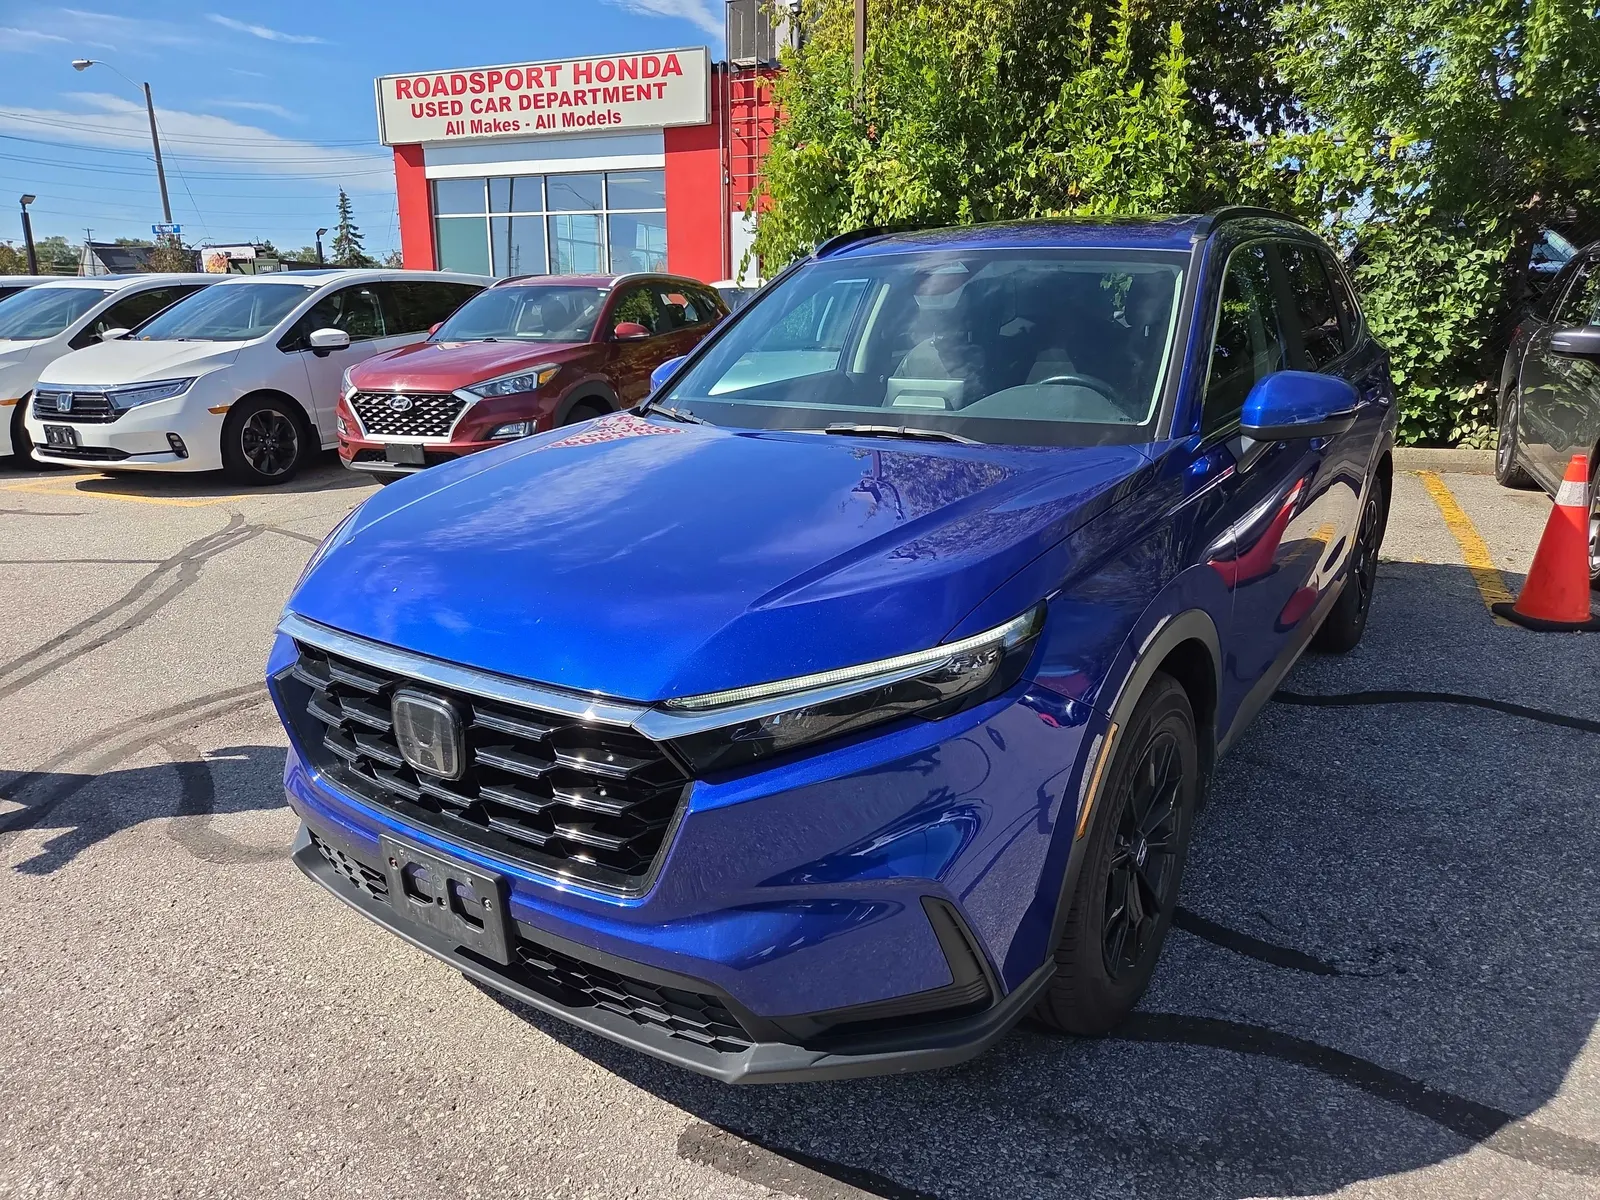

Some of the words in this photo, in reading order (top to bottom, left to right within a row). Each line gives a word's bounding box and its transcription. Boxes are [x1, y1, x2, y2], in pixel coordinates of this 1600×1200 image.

[396, 65, 562, 100] ROADSPORT
[573, 54, 682, 85] HONDA
[411, 100, 463, 118] USED
[470, 96, 511, 114] CAR
[519, 82, 667, 110] DEPARTMENT
[445, 121, 465, 135] All
[470, 119, 520, 134] Makes
[535, 114, 557, 129] All
[562, 111, 622, 127] Models
